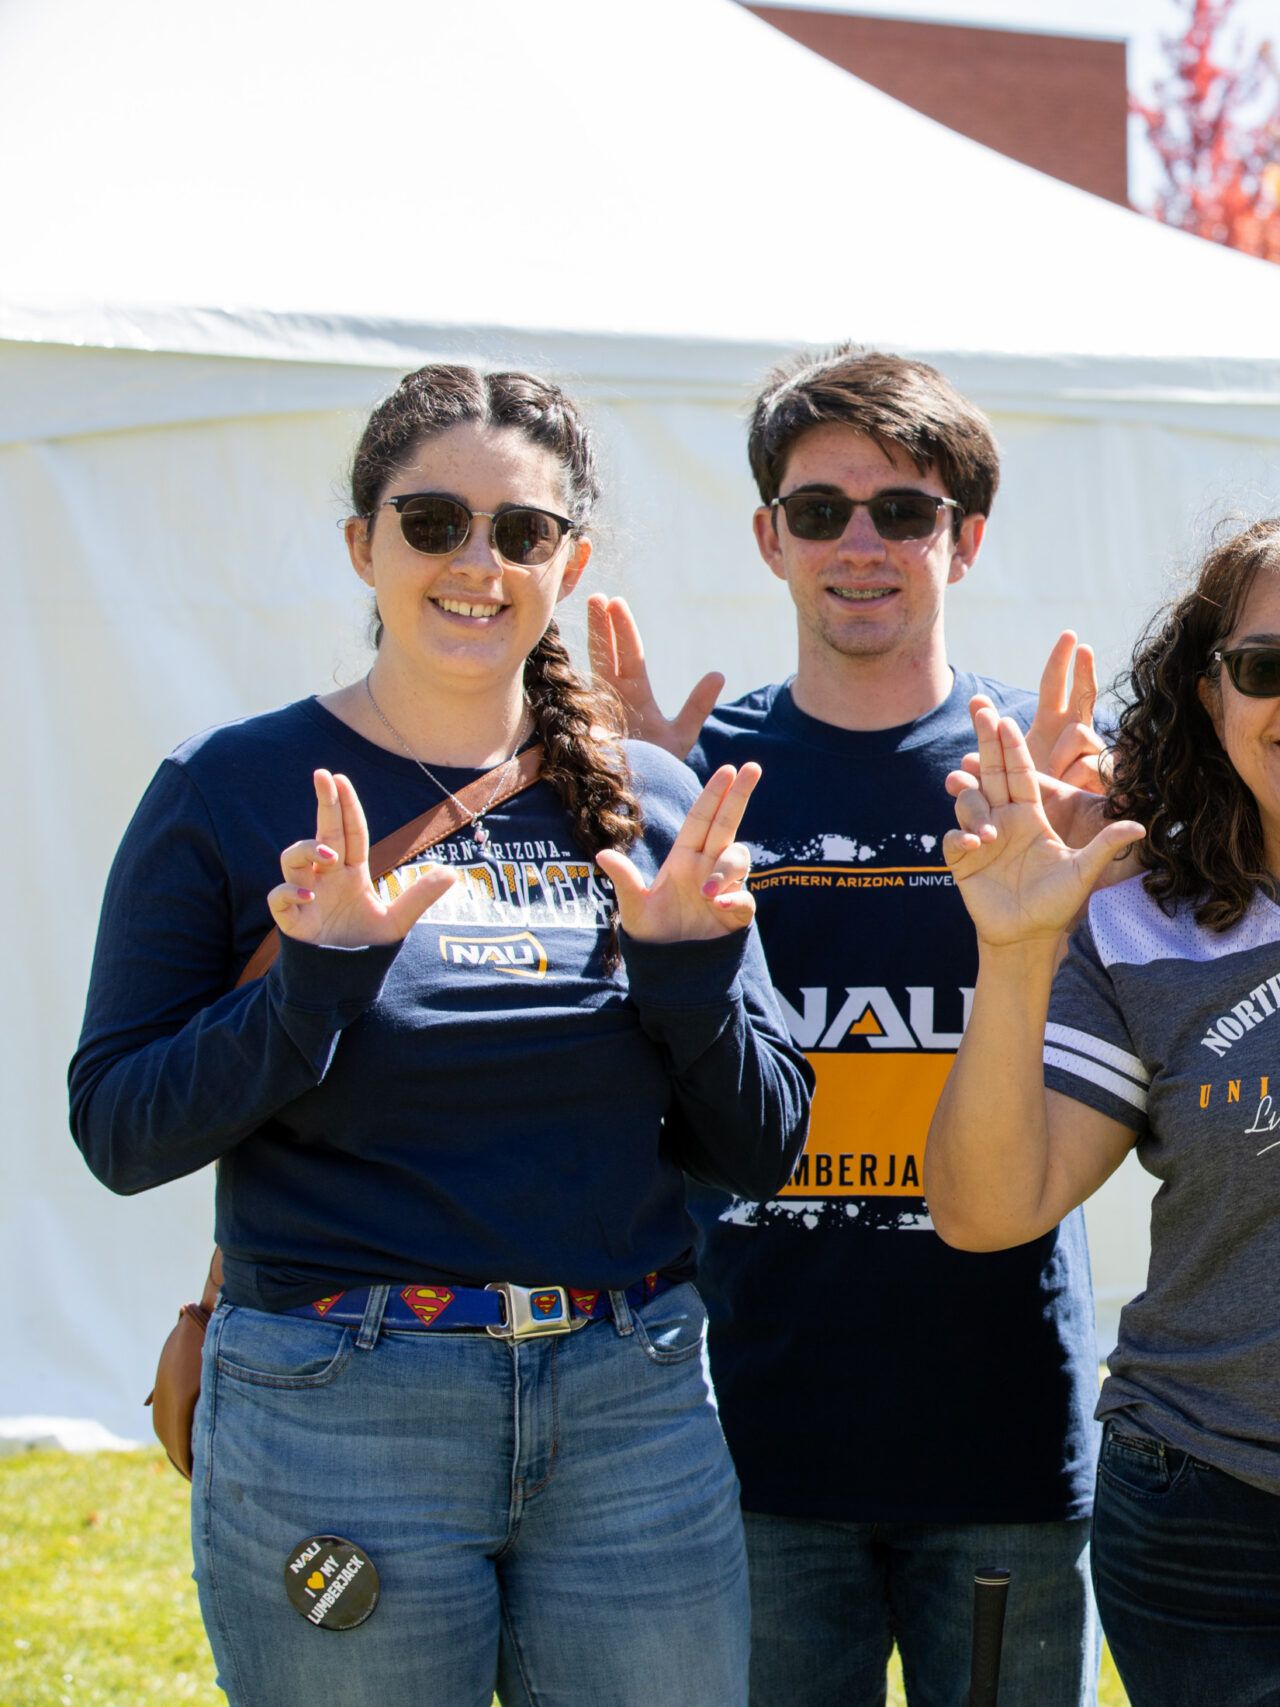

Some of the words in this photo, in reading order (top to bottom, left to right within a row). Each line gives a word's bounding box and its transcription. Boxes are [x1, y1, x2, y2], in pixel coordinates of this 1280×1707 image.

[491, 840, 561, 860] RIZONA
[750, 875, 832, 892] NORTHERN
[836, 876, 905, 888] ARIZONA
[909, 875, 955, 887] UNIVE
[452, 945, 534, 965] NAU
[774, 987, 976, 1048] NAU
[788, 1153, 919, 1187] MBERJA
[289, 1542, 321, 1574] NAU
[304, 1587, 316, 1599] I
[320, 1555, 339, 1578] MY
[307, 1554, 364, 1625] LUMBERJACK
